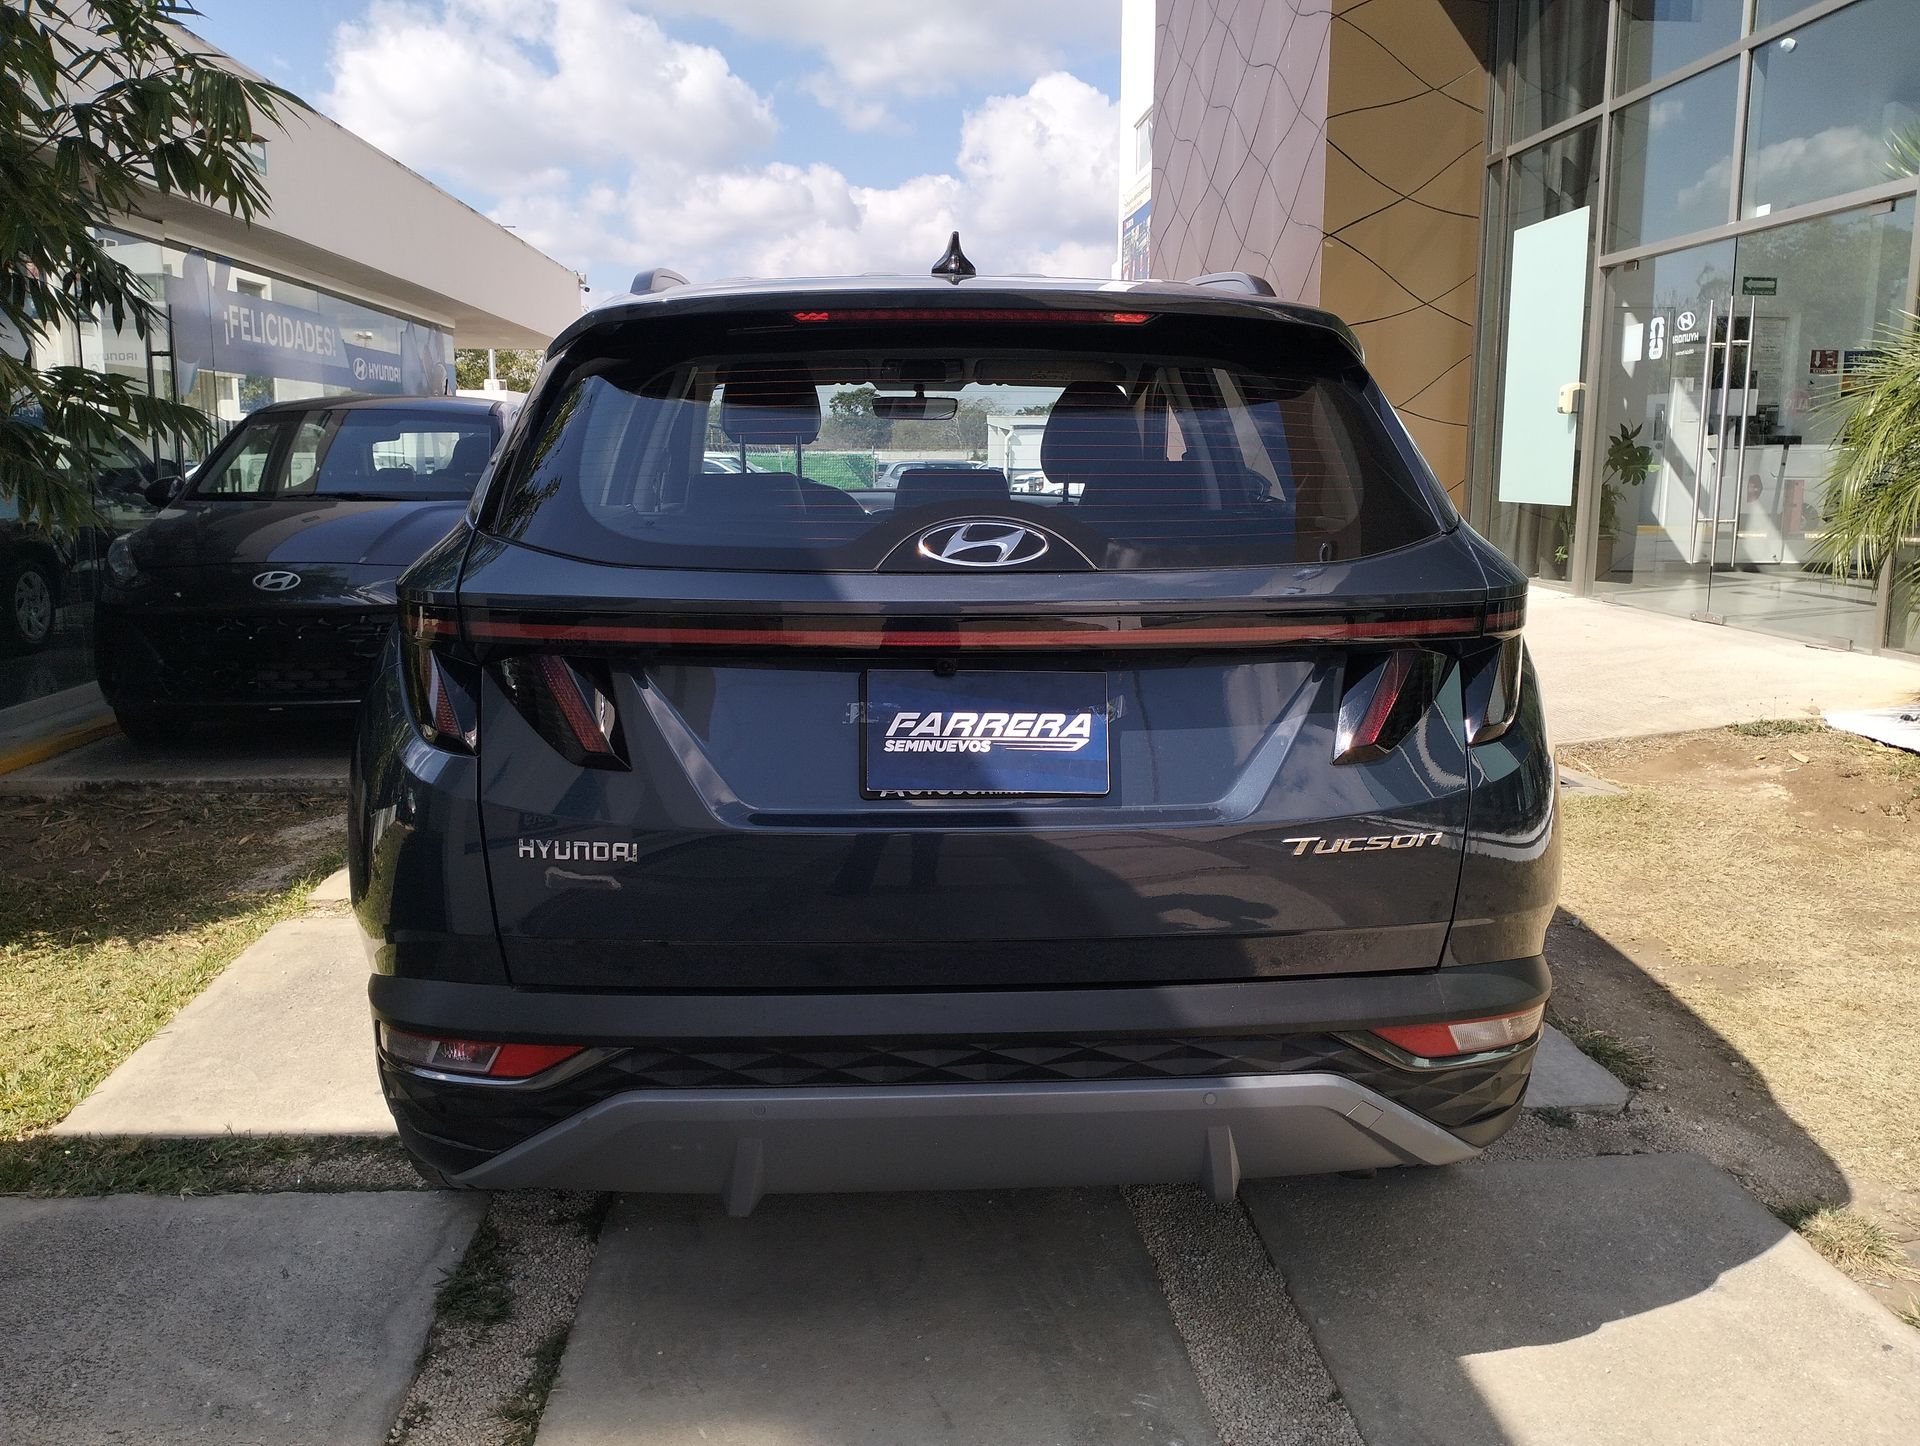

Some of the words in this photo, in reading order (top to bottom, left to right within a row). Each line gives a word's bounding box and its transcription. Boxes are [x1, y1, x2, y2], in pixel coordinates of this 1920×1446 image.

[223, 304, 337, 357] ¡FELICIDADES!
[885, 712, 1092, 738] FARRERA
[884, 739, 991, 753] SEMINUEVOS
[518, 838, 638, 863] HYUNDAI
